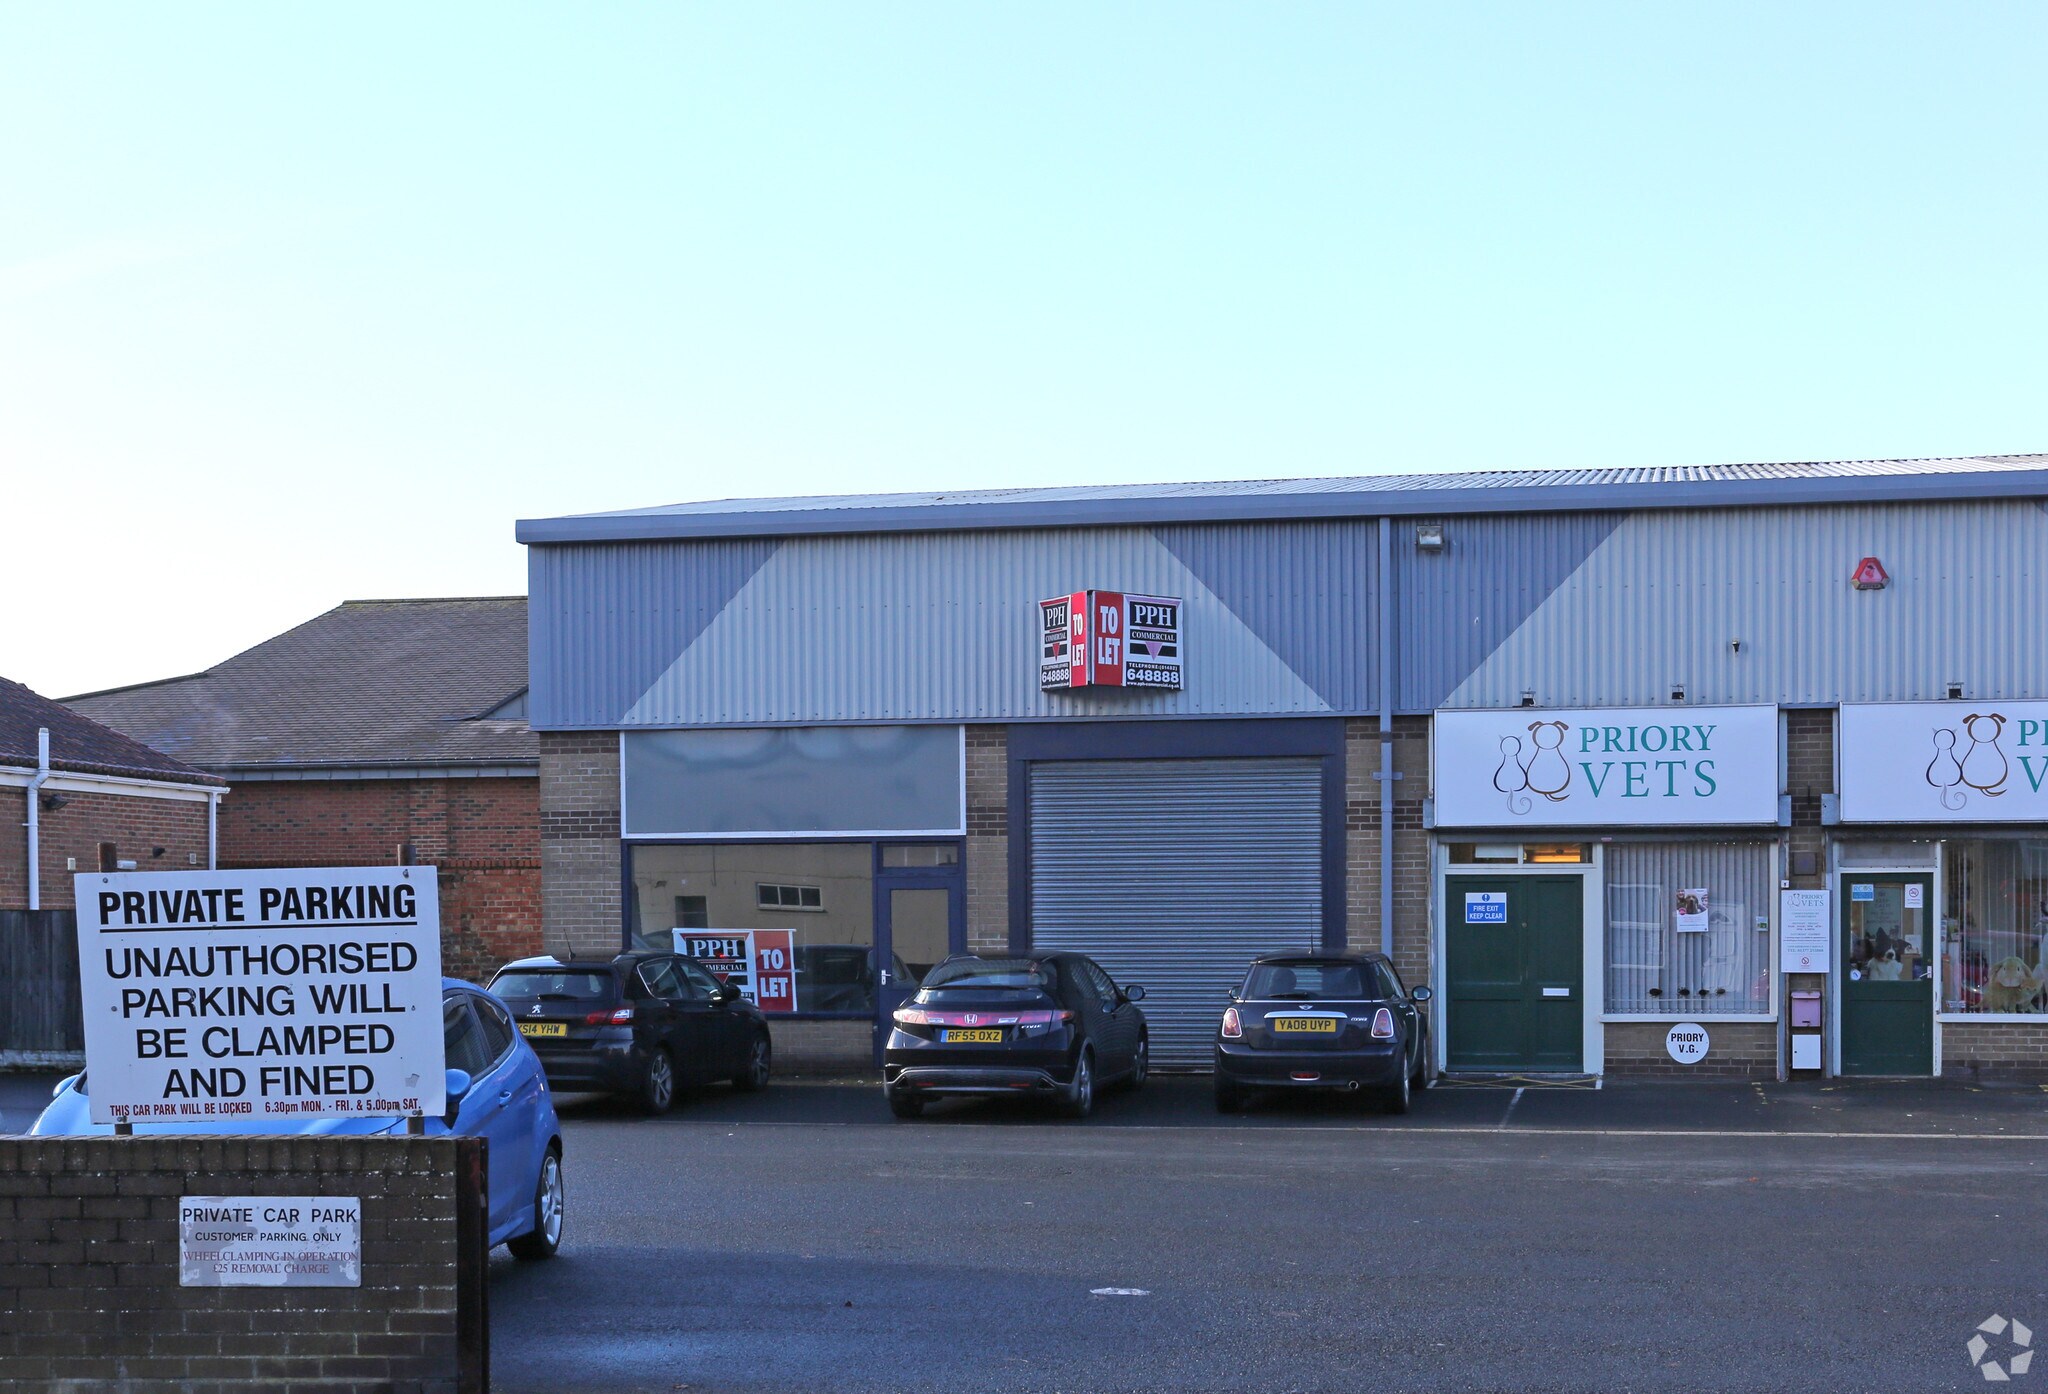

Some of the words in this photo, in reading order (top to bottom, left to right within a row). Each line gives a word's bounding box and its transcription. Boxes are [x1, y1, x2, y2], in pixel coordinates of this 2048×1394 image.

[1046, 606, 1066, 627] PPH
[1072, 613, 1084, 636] TO
[1100, 605, 1119, 634] TO
[1134, 604, 1172, 626] PPH
[1131, 631, 1175, 641] COMMERCIAL
[1072, 643, 1085, 667] LET
[1098, 636, 1120, 665] LET
[1042, 668, 1069, 683] 648888
[1127, 669, 1179, 683] 648888
[1578, 724, 1717, 752] PRIORY
[1578, 759, 1717, 798] VETS
[98, 888, 245, 925] PRIVATE
[259, 884, 416, 921] PARKING
[692, 939, 739, 957] PPH
[105, 942, 418, 979] UNAUTHORISED
[760, 949, 784, 969] TO
[760, 977, 788, 998] LET
[122, 985, 295, 1019] PARKING
[309, 983, 406, 1014] WILL
[540, 1024, 560, 1034] YHW
[1280, 1020, 1307, 1029] YA08
[1310, 1020, 1331, 1030] UYP
[136, 1028, 188, 1059] BE
[201, 1023, 395, 1058] CLAMPED
[948, 1031, 976, 1041] RF55
[979, 1031, 1000, 1041] OXZ
[1671, 1033, 1704, 1042] PRIORY
[1678, 1044, 1699, 1053] V.G.
[162, 1067, 246, 1098] AND
[260, 1065, 375, 1097] FINED
[110, 1105, 130, 1116] THIS
[133, 1104, 151, 1116] CAR
[154, 1104, 177, 1115] PARK
[180, 1103, 201, 1115] WILL
[205, 1103, 216, 1114] BE
[219, 1102, 252, 1114] LOCKED
[265, 1101, 298, 1114] 6.30pm
[301, 1101, 325, 1112] MON.
[336, 1100, 353, 1111] FRI.
[356, 1100, 363, 1110] &
[367, 1098, 400, 1112] 5.00pm
[403, 1098, 421, 1110] SAT.
[182, 1208, 253, 1223] PRIVATE
[264, 1208, 300, 1223] CAR
[311, 1208, 357, 1223] PARK
[195, 1232, 254, 1241] CUSTOMER
[260, 1232, 307, 1242] PARKING
[313, 1232, 342, 1242] ONLY
[184, 1251, 280, 1262] WHEELCLAMPING
[283, 1251, 295, 1262] IN
[300, 1251, 359, 1262] OPERATION
[213, 1264, 228, 1273] £25
[231, 1264, 281, 1273] REMOVAL
[284, 1264, 330, 1274] CHARGE
